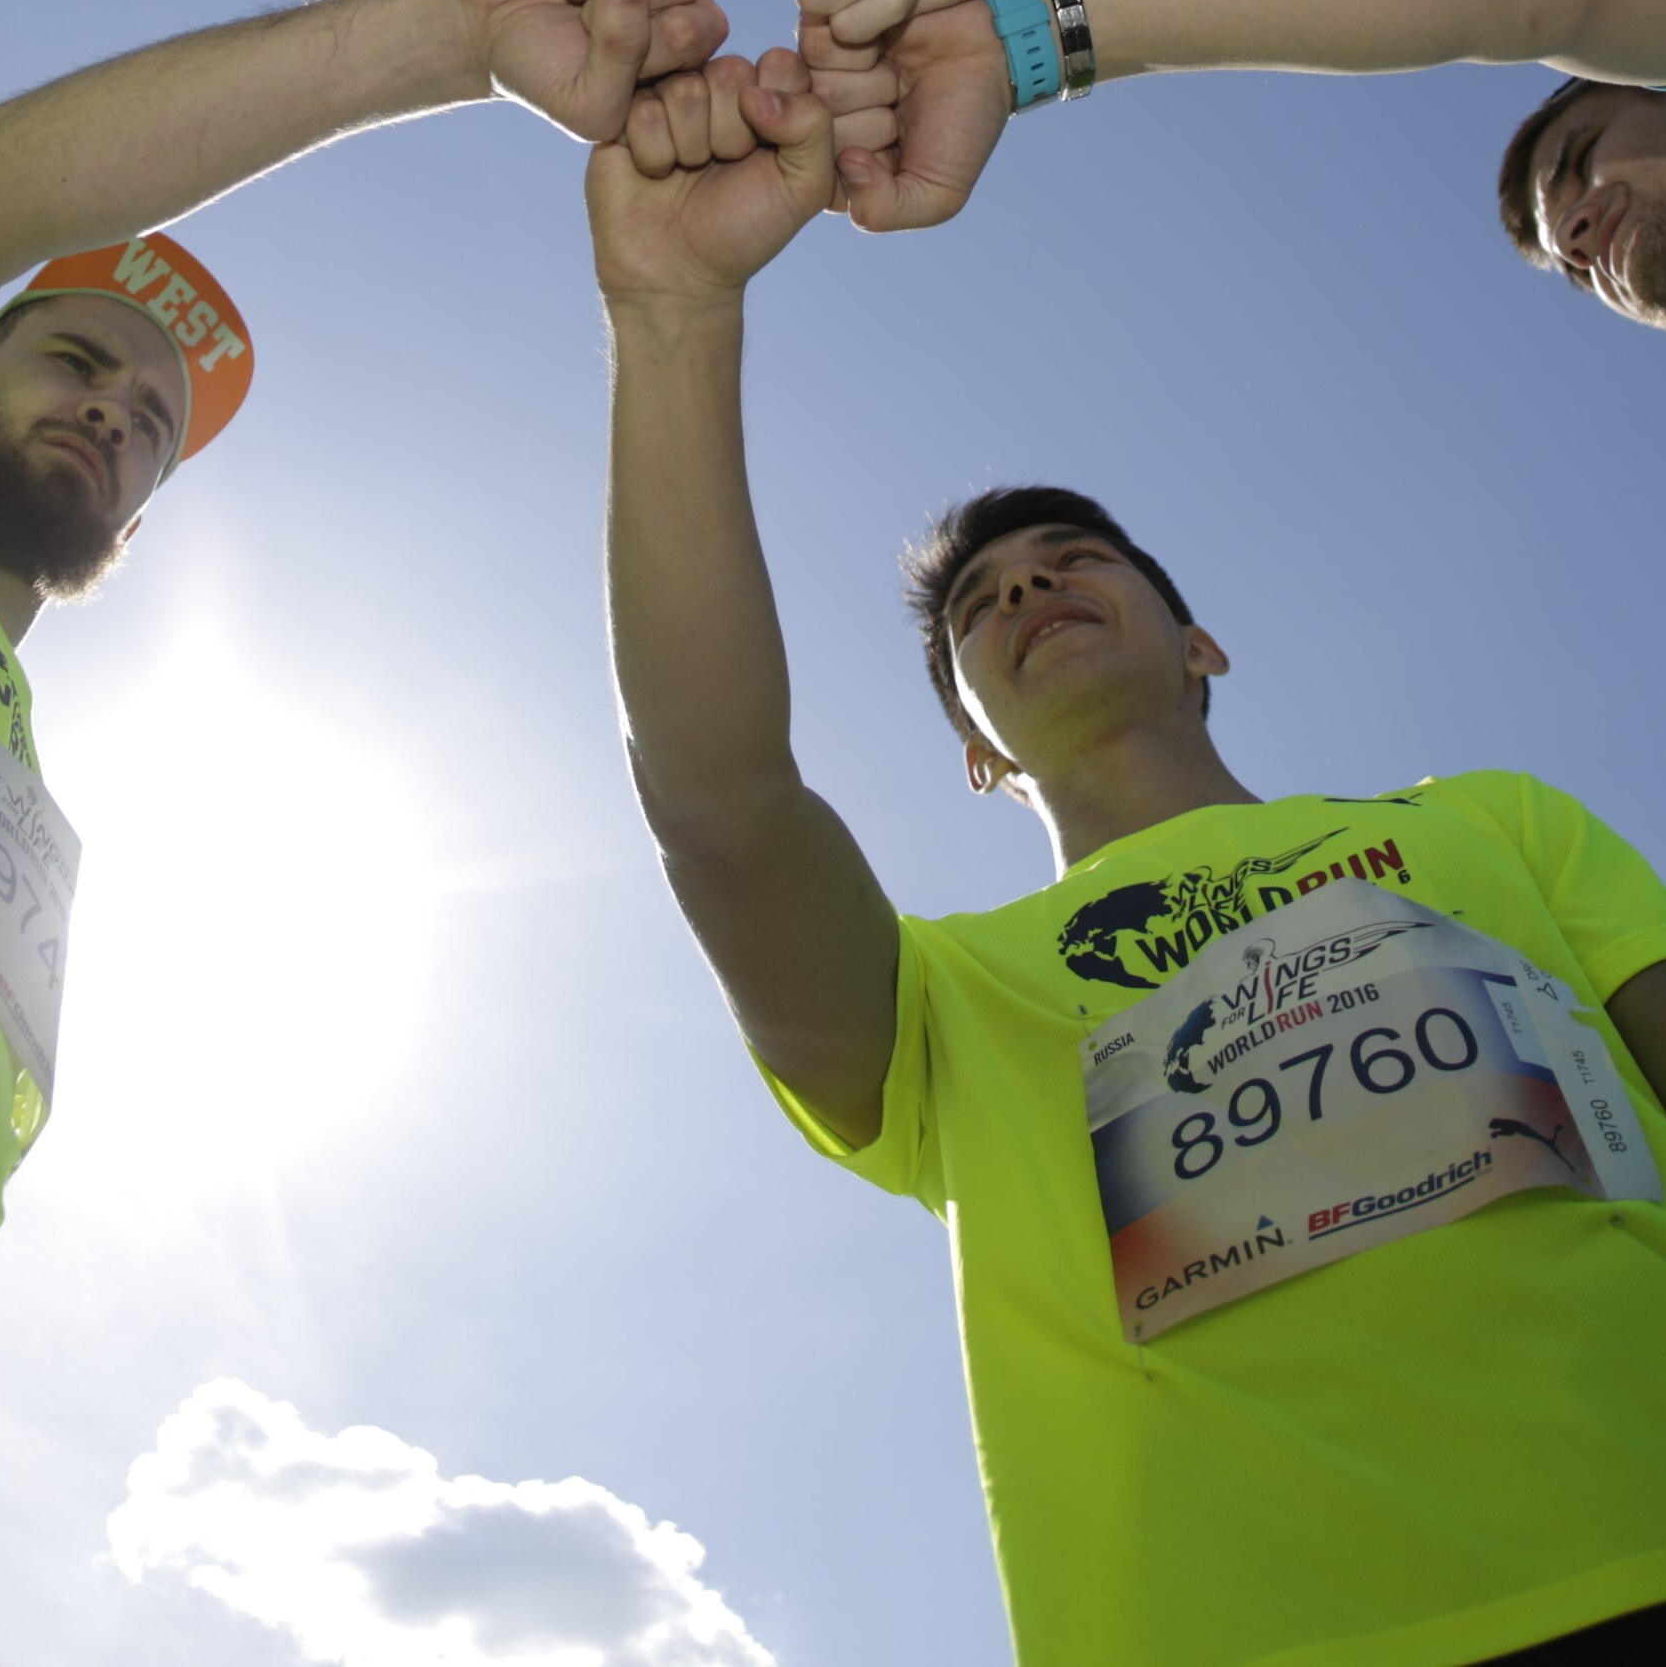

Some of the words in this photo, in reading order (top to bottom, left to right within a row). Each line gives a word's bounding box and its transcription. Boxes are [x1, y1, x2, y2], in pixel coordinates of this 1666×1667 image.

[113, 238, 245, 373] WEST
[1221, 1006, 1245, 1030] FOR
[1248, 972, 1319, 1026] LIFE
[1222, 937, 1351, 1012] WINGS
[1327, 983, 1380, 1014] 2016
[1501, 1001, 1523, 1035] T1745
[1093, 1033, 1135, 1066] RUSSIA
[1572, 1050, 1596, 1085] T1745
[1171, 1007, 1479, 1180] 89760
[1590, 1099, 1627, 1153] 89760
[1308, 1149, 1493, 1233] BFGoodrich
[1136, 1227, 1285, 1310] GARMIN
